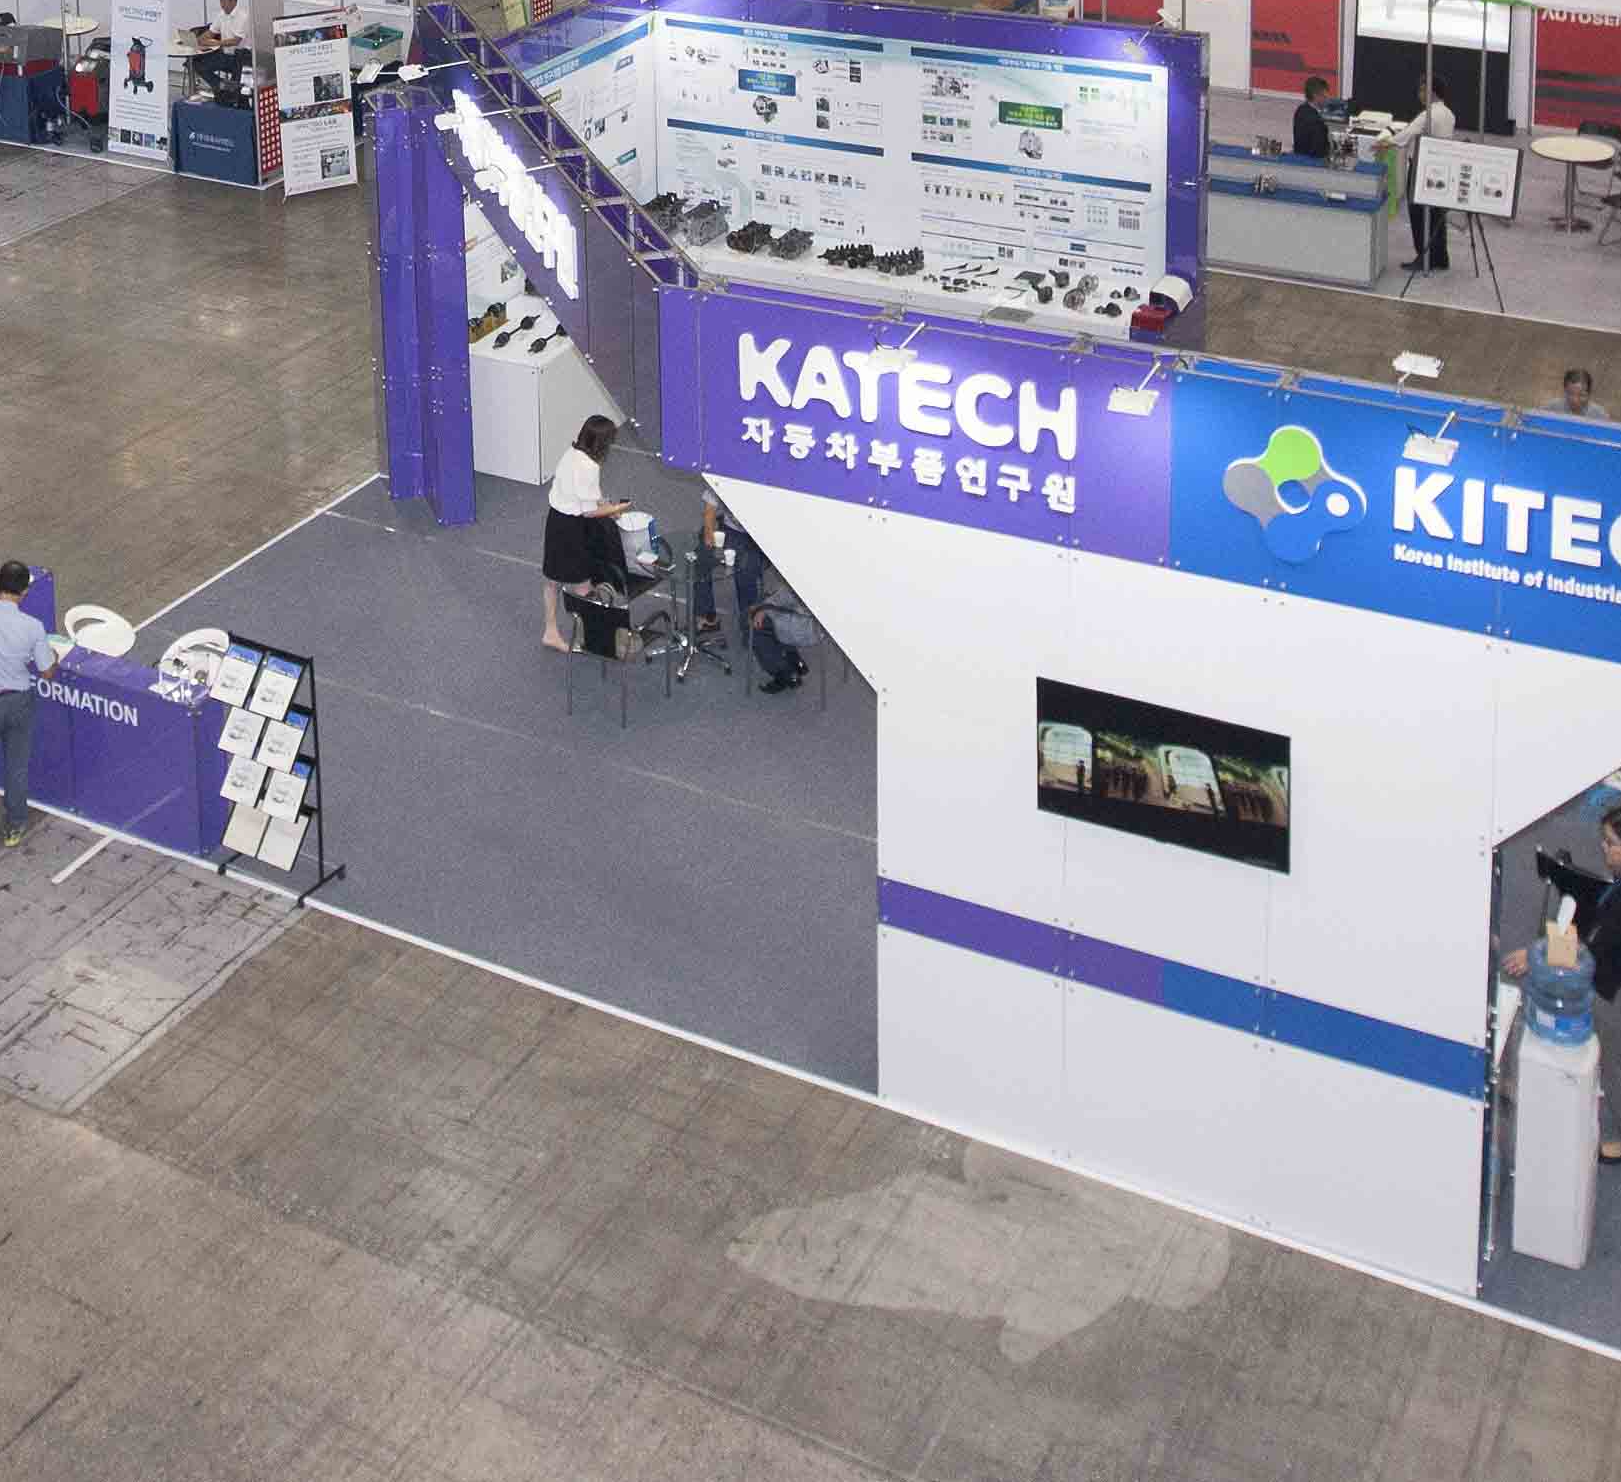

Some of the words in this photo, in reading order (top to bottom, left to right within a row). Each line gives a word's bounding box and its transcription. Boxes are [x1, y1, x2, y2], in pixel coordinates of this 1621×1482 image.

[737, 331, 1080, 463] KATECH
[739, 415, 1080, 517] 자동차부품연구원
[1393, 543, 1444, 572] Korea
[1446, 552, 1520, 585] Institute
[1522, 567, 1546, 590] of
[30, 675, 140, 728] FORMATION
